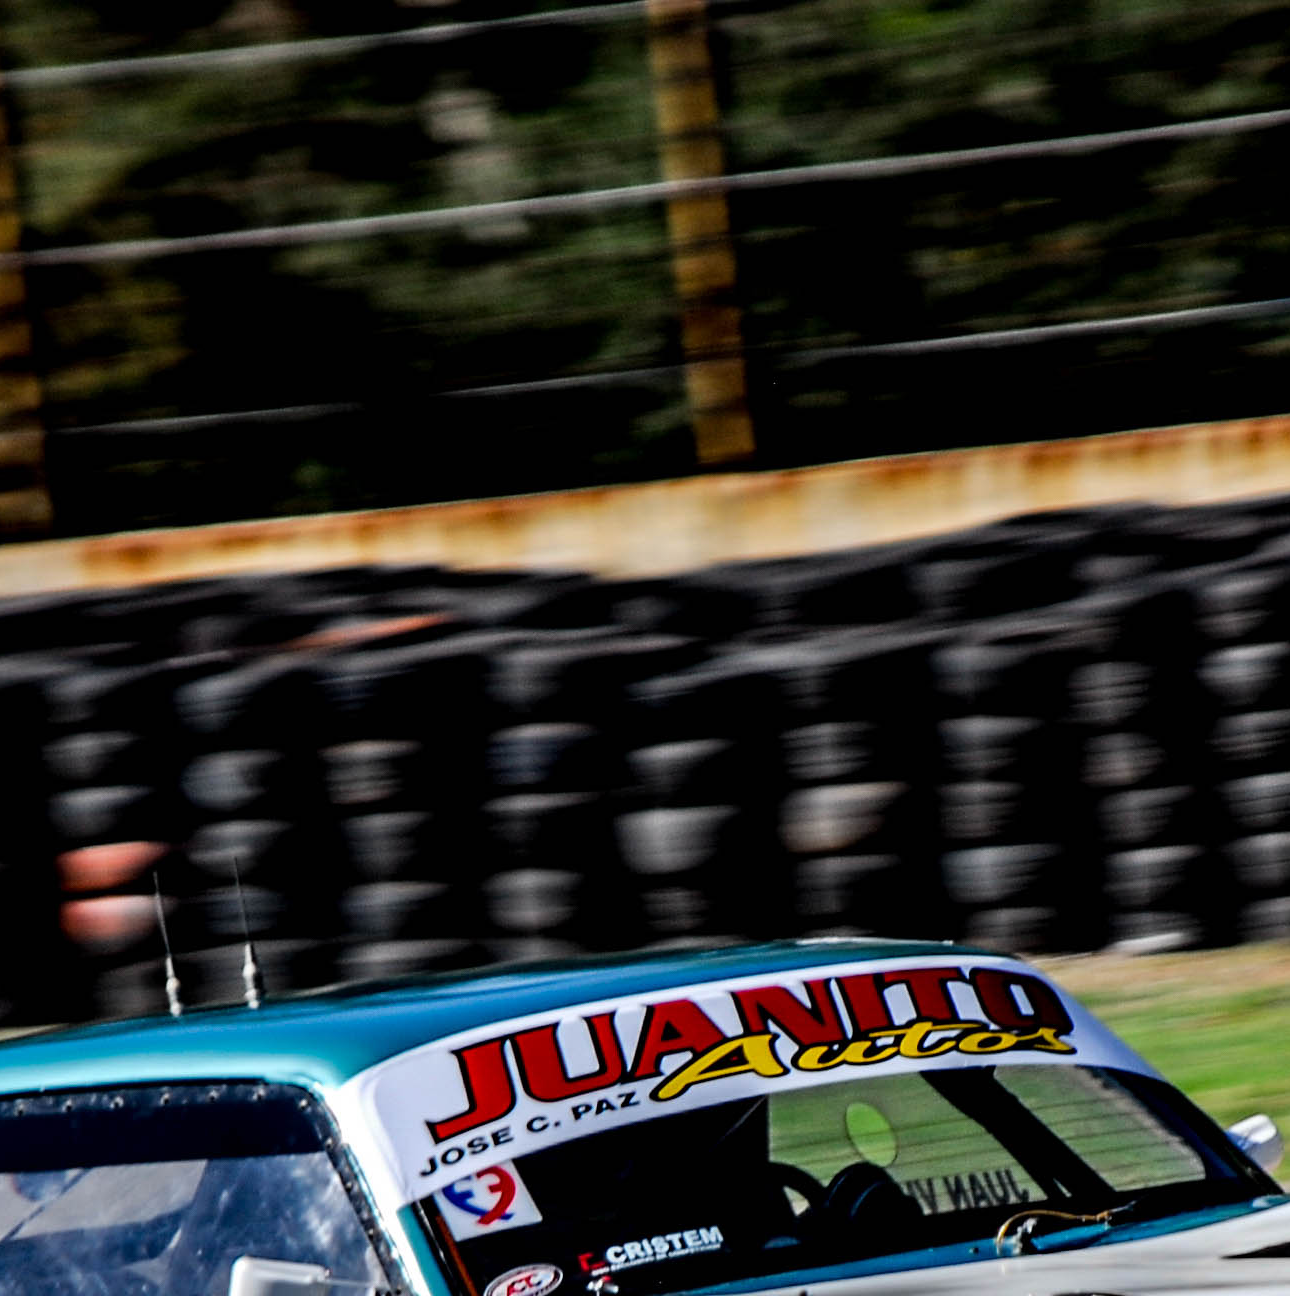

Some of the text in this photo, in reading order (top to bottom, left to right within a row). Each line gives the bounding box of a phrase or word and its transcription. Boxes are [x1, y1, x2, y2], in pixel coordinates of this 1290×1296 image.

[425, 966, 1075, 1145] JUANITO
[649, 1019, 1078, 1102] Autos
[419, 1091, 641, 1177] JOSE C. PAZ
[605, 1225, 724, 1265] CRISTEM
